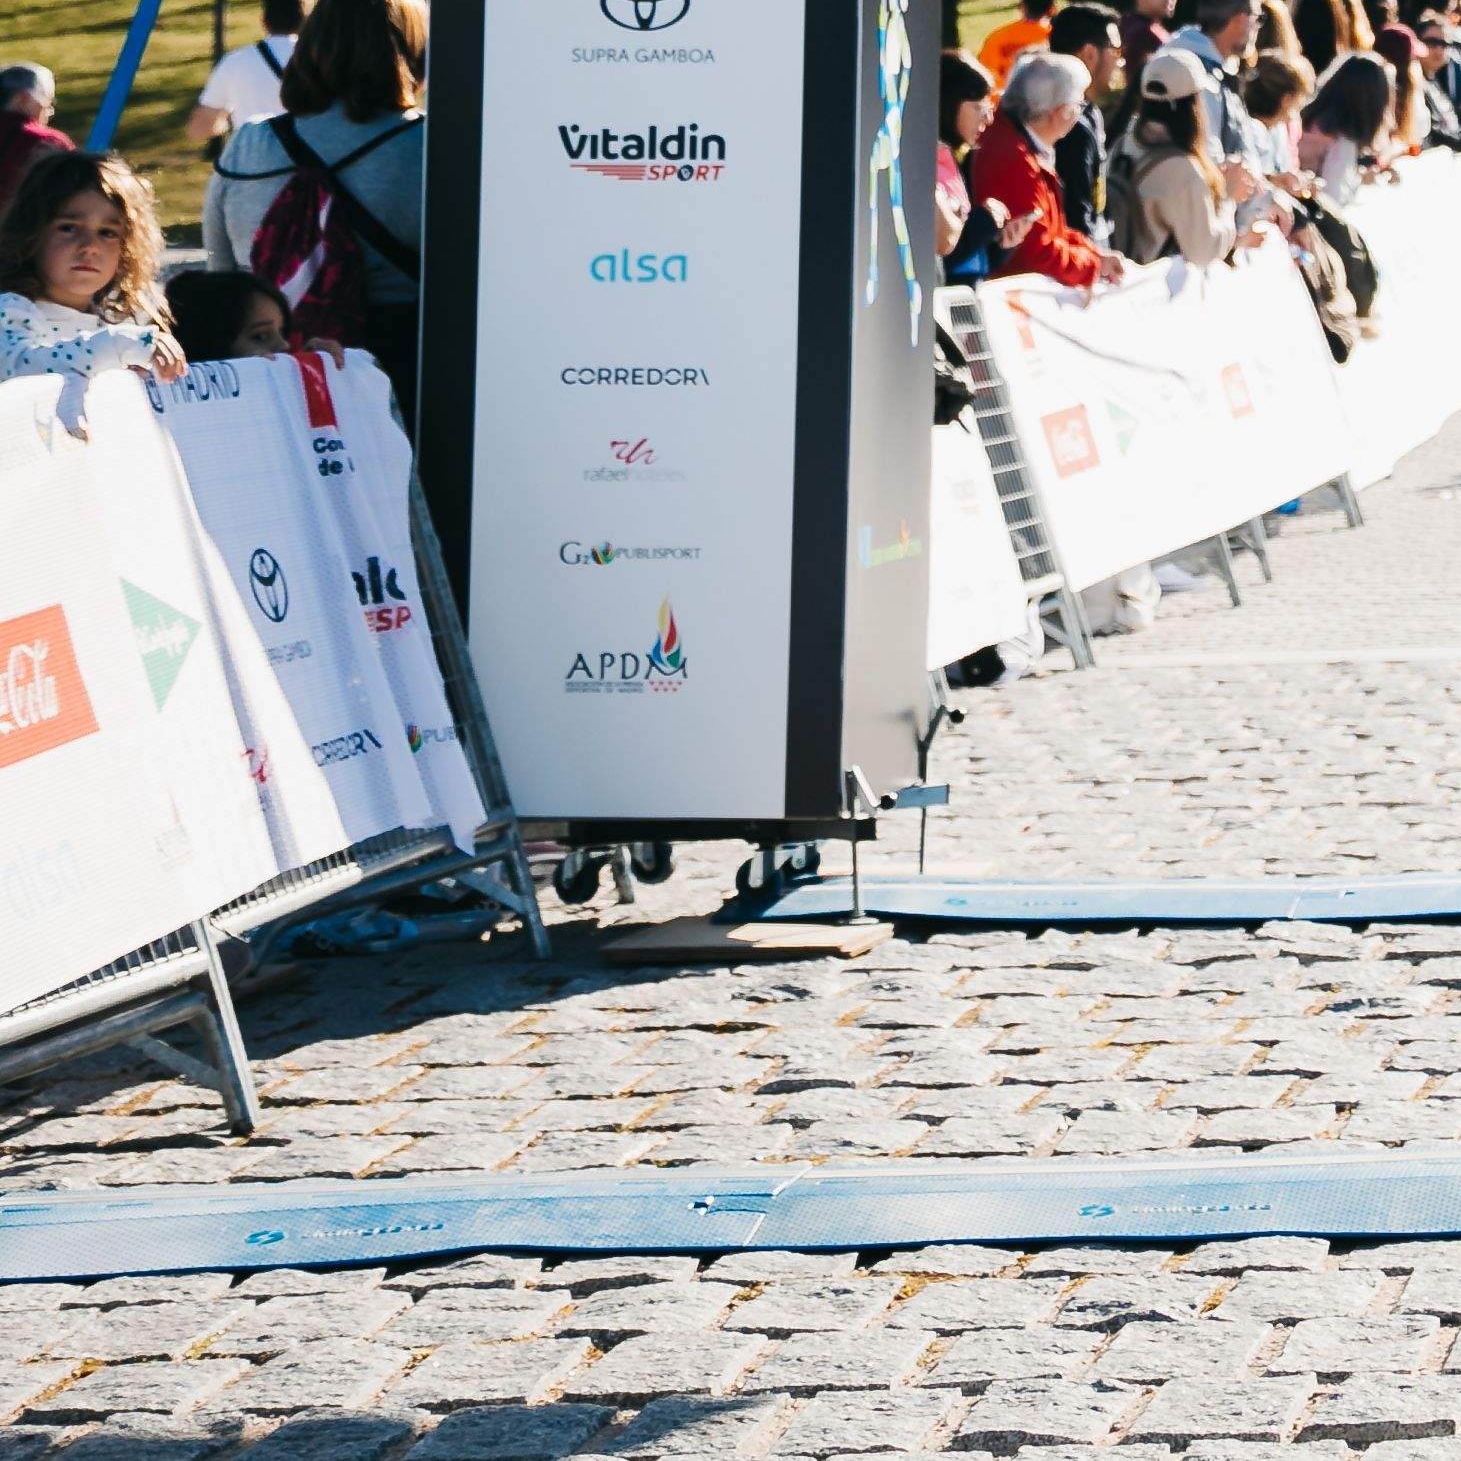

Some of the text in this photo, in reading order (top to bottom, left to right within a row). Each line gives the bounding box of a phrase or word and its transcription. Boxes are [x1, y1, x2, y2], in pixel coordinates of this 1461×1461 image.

[572, 49, 715, 63] SUPRA GAMBOA
[558, 123, 727, 160] Vitaldin
[648, 164, 726, 182] SPORT
[591, 248, 688, 282] alsa
